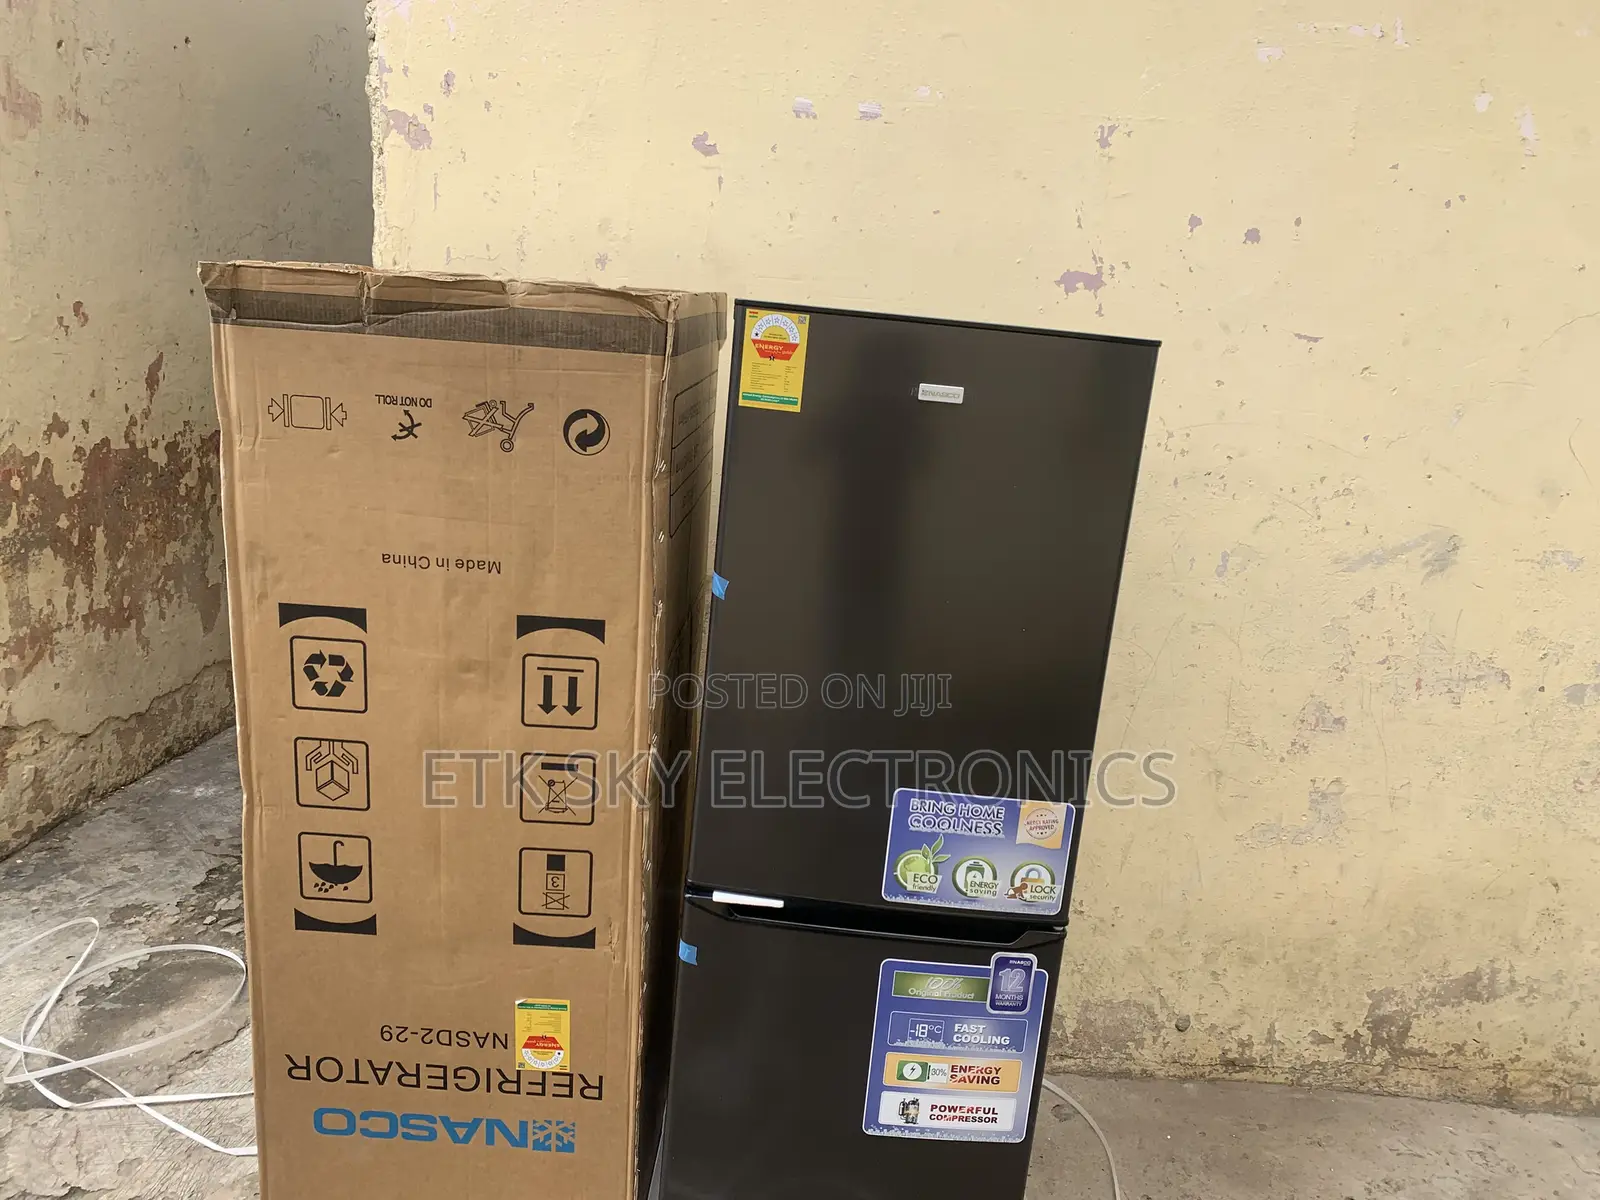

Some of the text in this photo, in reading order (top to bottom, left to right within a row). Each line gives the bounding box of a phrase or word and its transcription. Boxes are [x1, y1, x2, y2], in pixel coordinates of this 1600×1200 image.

[755, 343, 784, 351] ENERGY
[375, 394, 432, 408] DO NOT ROLL
[381, 553, 501, 574] Made in China
[909, 798, 1006, 821] BRING HOME
[908, 814, 1006, 837] COOLNESS
[913, 873, 938, 885] ECO
[912, 883, 937, 892] friendly
[970, 880, 999, 891] ENERGY
[1030, 884, 1057, 895] LOCK
[969, 888, 998, 897] saving
[924, 976, 964, 990] 100%
[999, 968, 1026, 993] 12
[908, 987, 974, 1000] Original Product
[995, 993, 1024, 1001] MONTHS
[954, 1023, 986, 1034] FAST
[380, 1025, 508, 1050] NASD2-29
[953, 1033, 1010, 1046] COOLING
[931, 1067, 947, 1077] 30%
[951, 1064, 1001, 1075] ENERGY
[285, 1053, 603, 1101] REFRIGERATOR
[950, 1074, 1000, 1085] SAVING
[930, 1104, 999, 1116] POWERFUL
[929, 1113, 998, 1124] COMPRESSOR
[313, 1107, 528, 1149] NASCO
